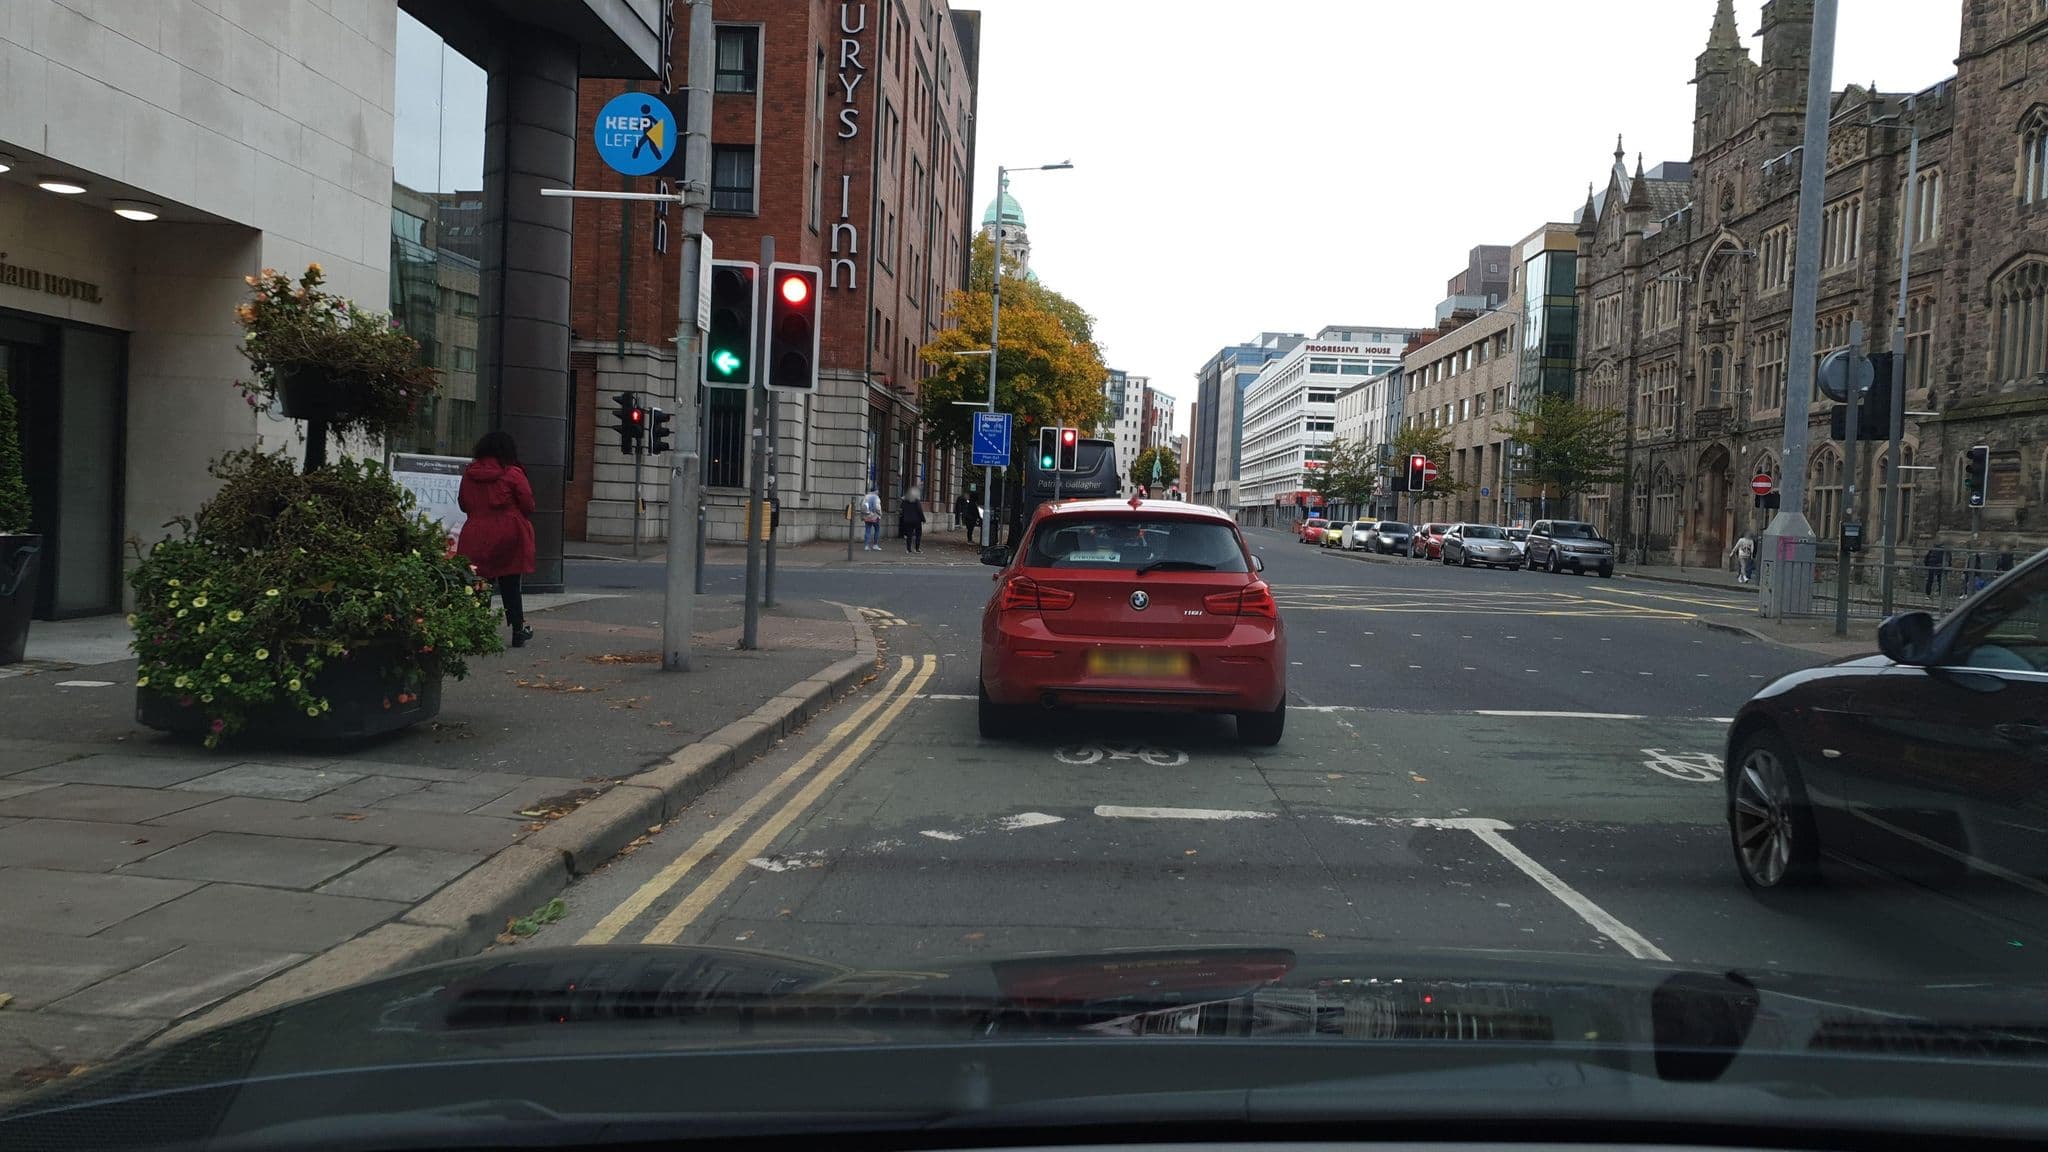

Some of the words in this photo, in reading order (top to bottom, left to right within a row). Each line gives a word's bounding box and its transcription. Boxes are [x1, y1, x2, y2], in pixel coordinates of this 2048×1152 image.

[838, 3, 866, 138] URYS
[605, 116, 651, 131] KEEP
[605, 133, 643, 148] LEFT
[830, 175, 858, 289] Inn
[44, 273, 103, 304] HOTEL
[1305, 345, 1359, 354] PROGRESSIVE
[1065, 480, 1103, 490] Gallagher
